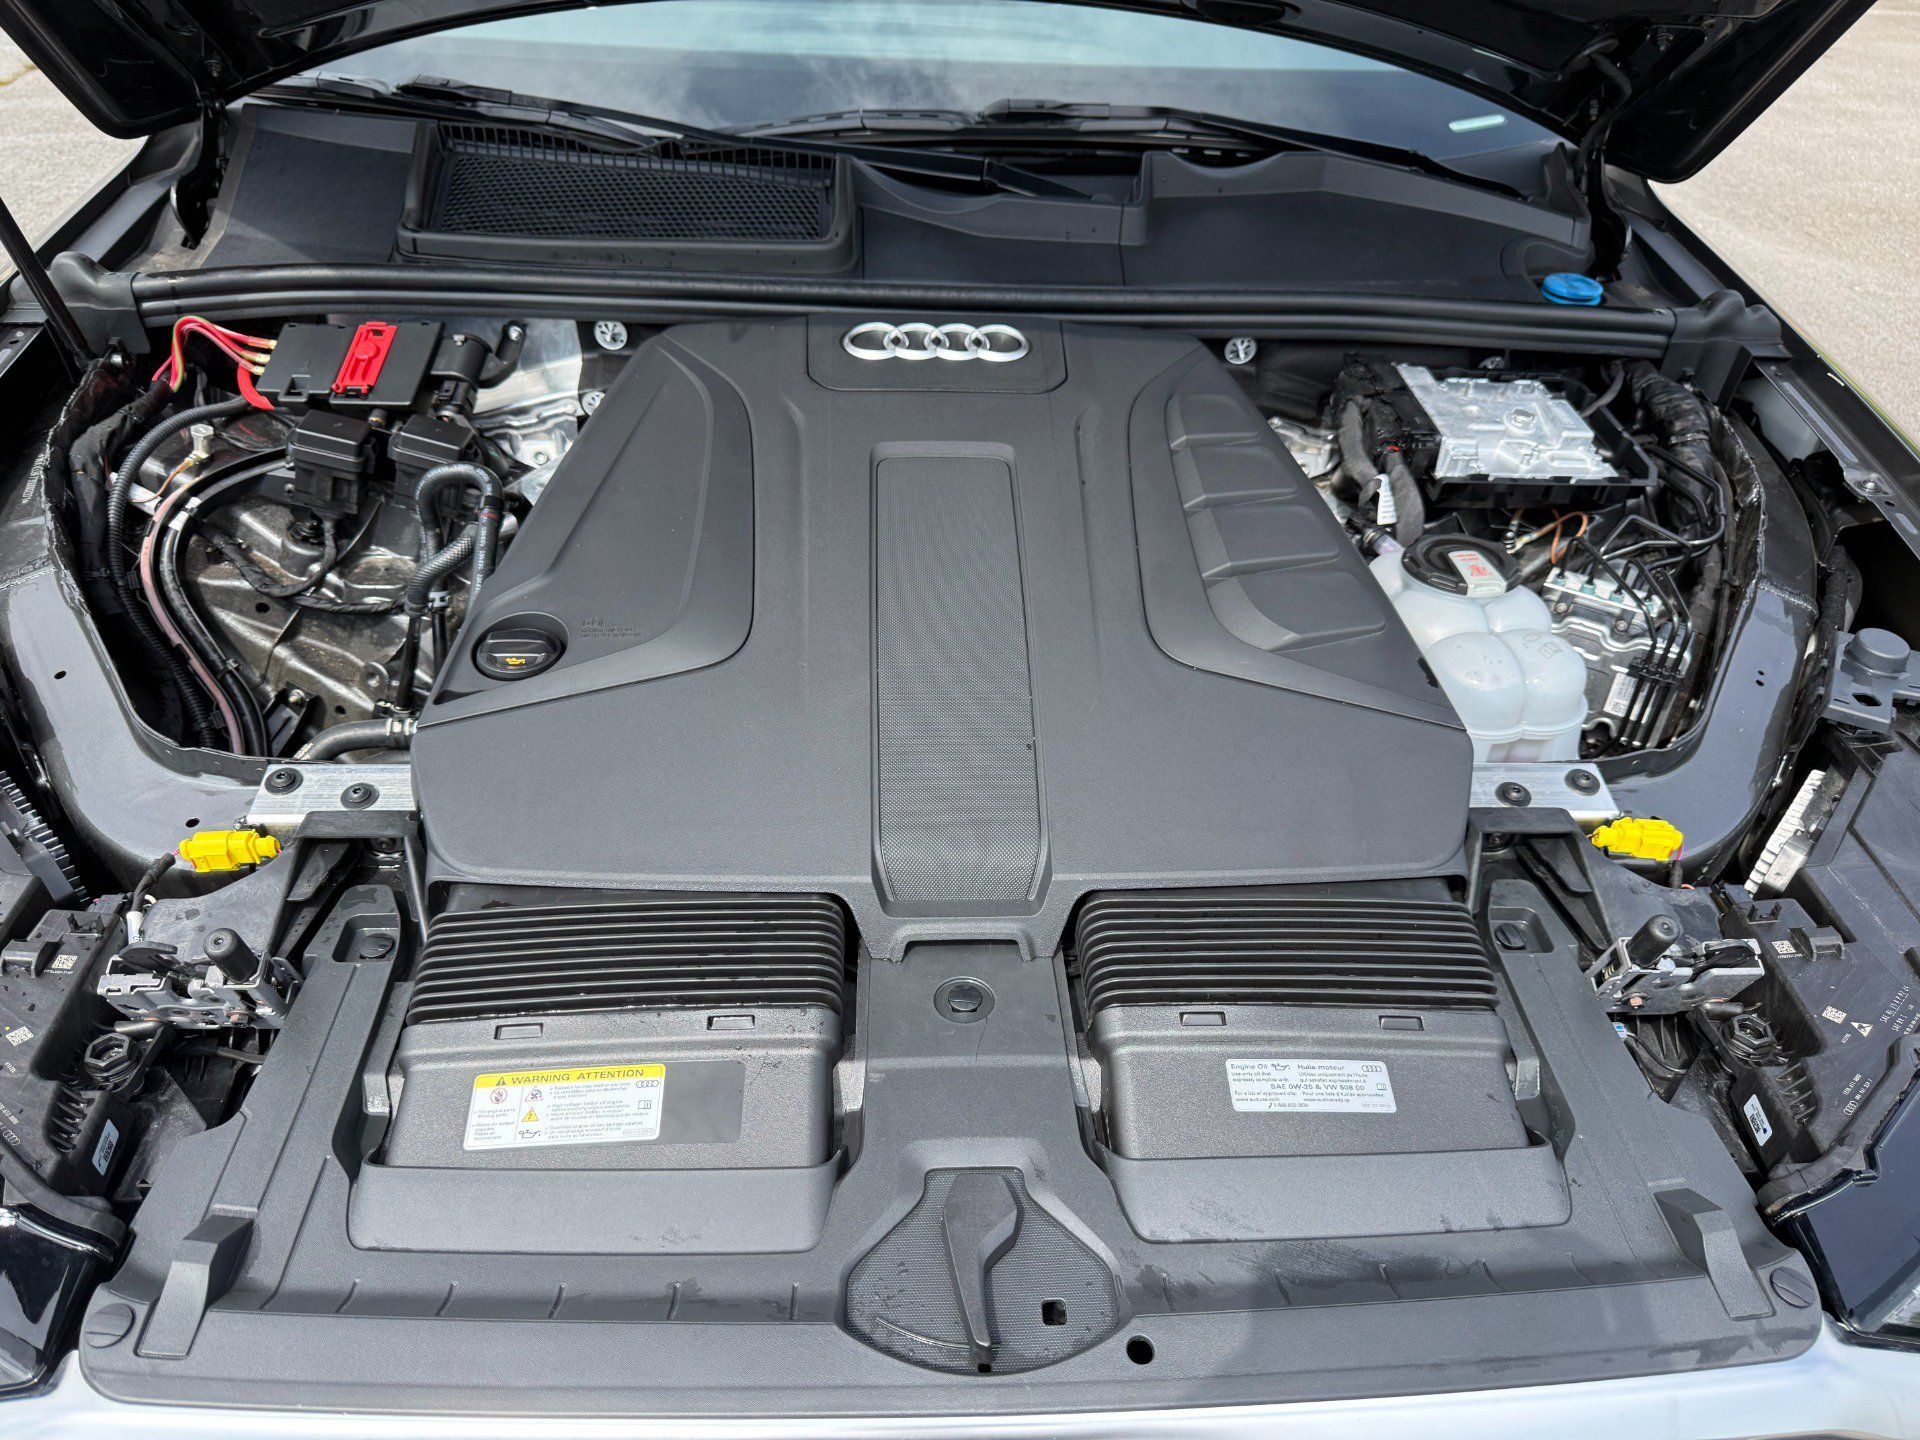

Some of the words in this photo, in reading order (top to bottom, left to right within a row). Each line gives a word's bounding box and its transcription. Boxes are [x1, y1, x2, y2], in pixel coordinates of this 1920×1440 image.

[1230, 1063, 1256, 1072] Engine
[511, 1073, 570, 1085] WARNING
[577, 1069, 644, 1080] ATTENTION
